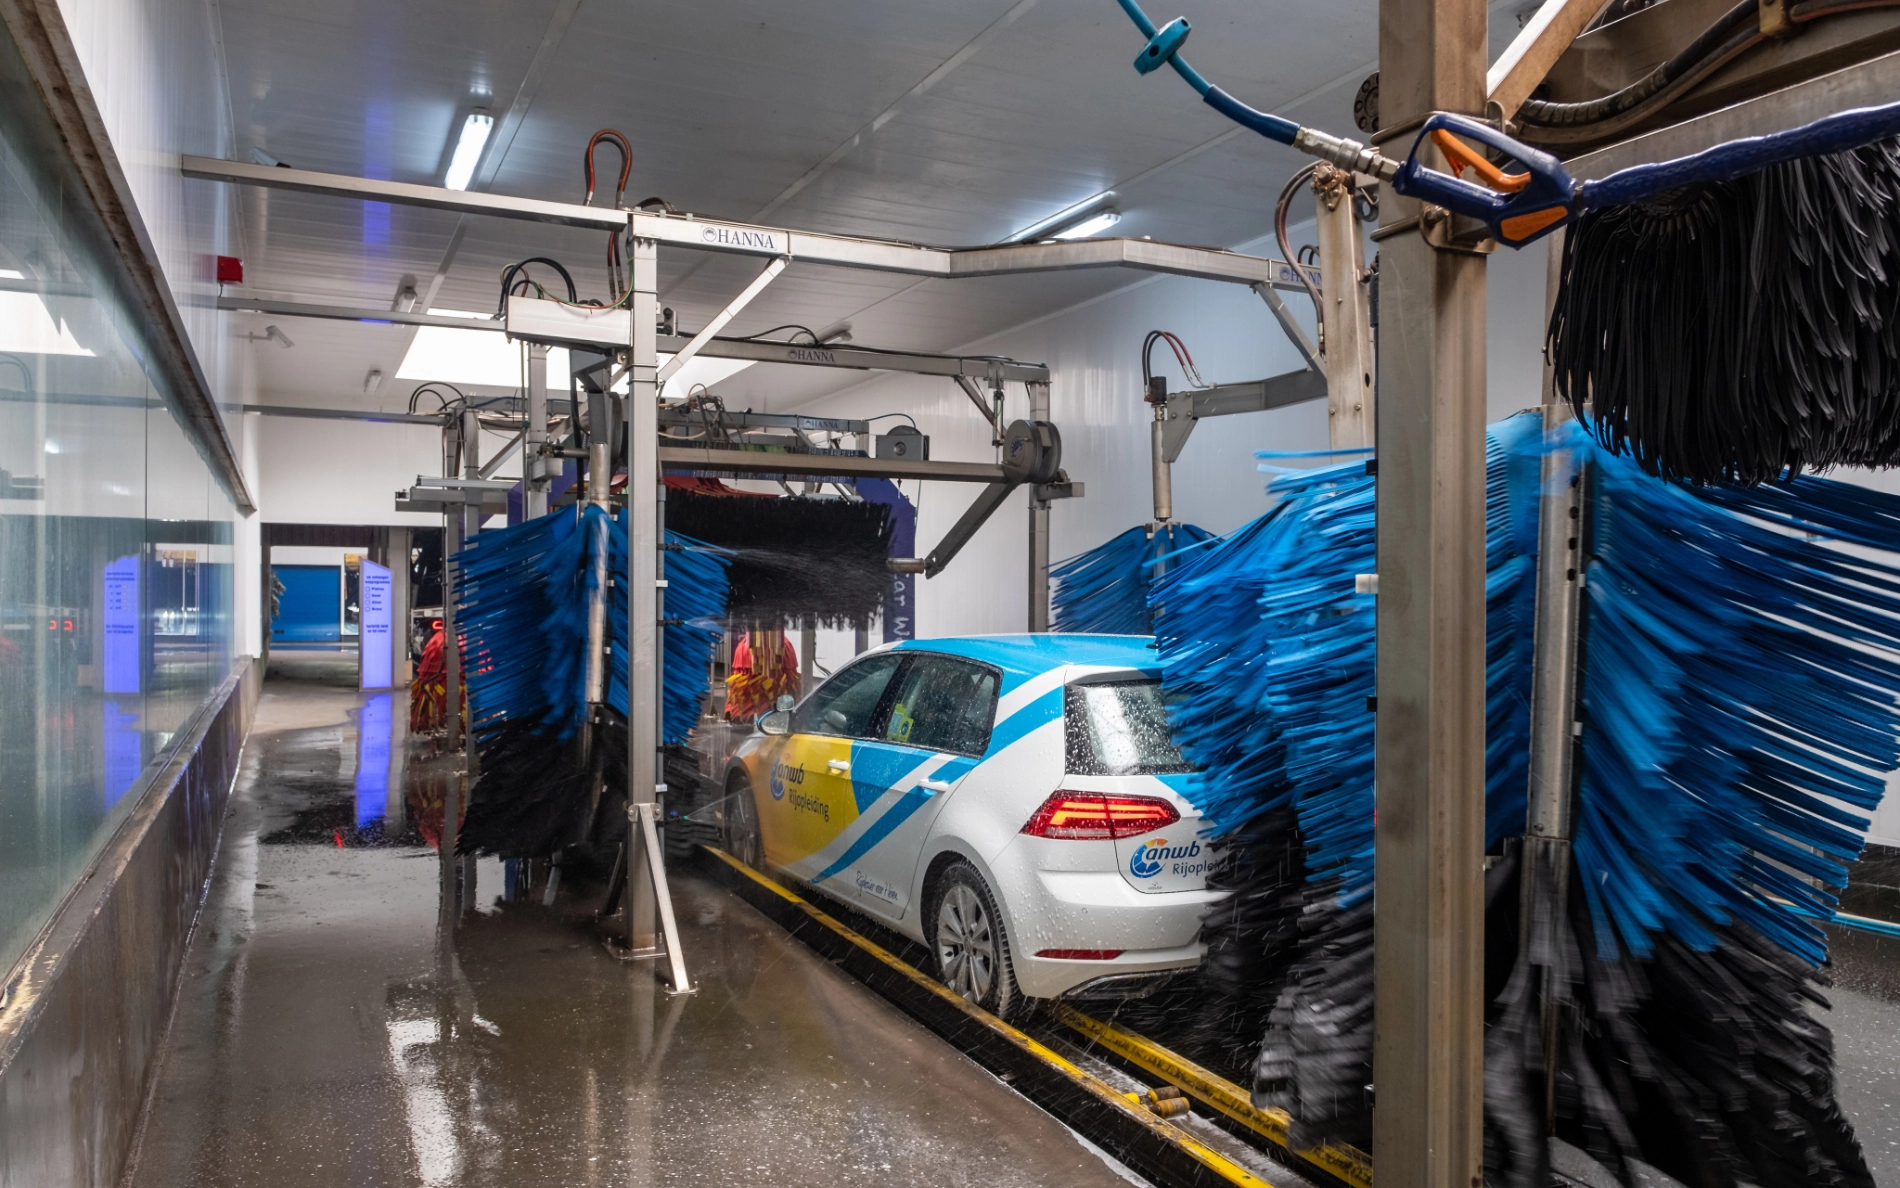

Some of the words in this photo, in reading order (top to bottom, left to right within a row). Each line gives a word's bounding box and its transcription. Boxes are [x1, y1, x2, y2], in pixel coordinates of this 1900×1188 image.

[718, 229, 775, 249] HANNA
[797, 350, 835, 362] HANNA
[778, 762, 805, 785] anwb
[789, 788, 830, 823] Rijopleiding
[1146, 840, 1201, 861] anwb
